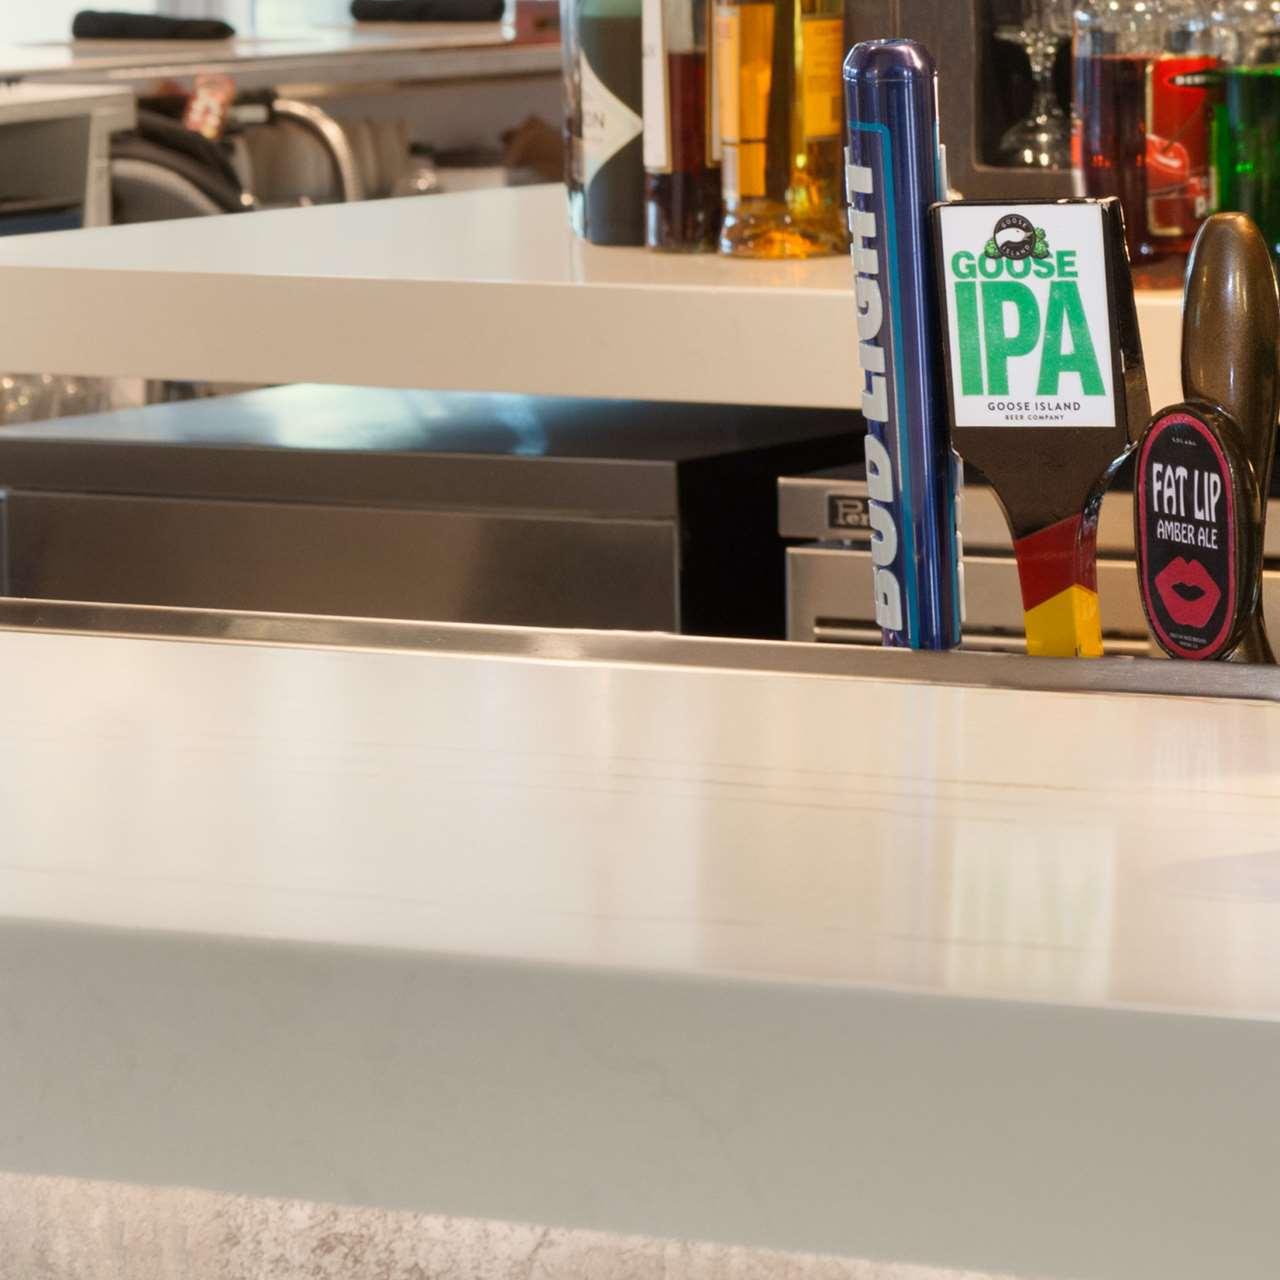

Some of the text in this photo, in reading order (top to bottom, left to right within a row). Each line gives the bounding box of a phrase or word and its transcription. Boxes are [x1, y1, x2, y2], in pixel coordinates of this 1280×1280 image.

[951, 250, 1079, 279] GOOSE
[954, 280, 1106, 396] IPA
[844, 146, 903, 632] BUD LIGHT
[987, 401, 1081, 412] GOOSE ISLAND
[1152, 461, 1221, 523] FAT LIP
[1156, 519, 1218, 549] AMBER ALE
